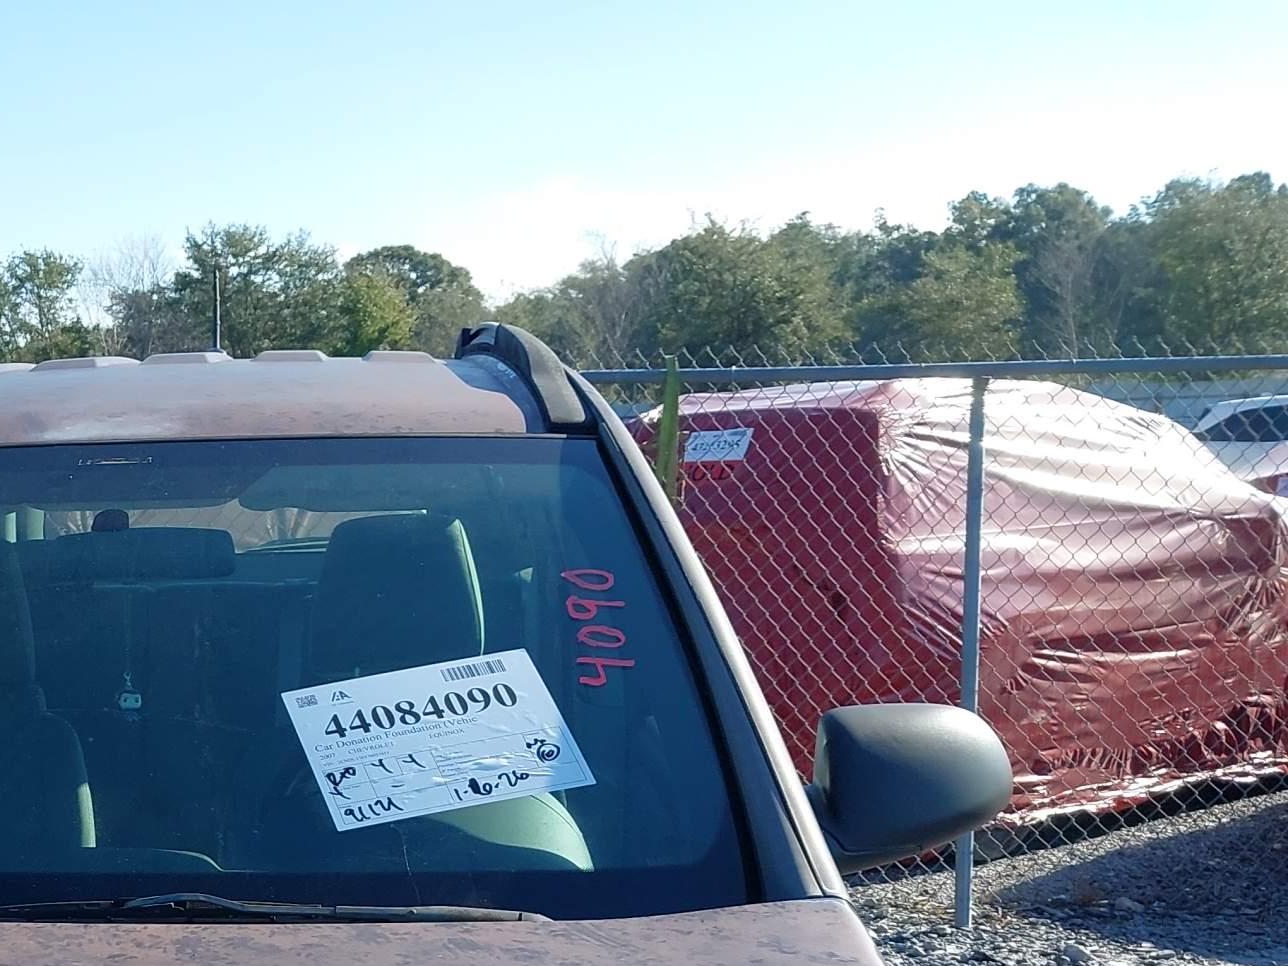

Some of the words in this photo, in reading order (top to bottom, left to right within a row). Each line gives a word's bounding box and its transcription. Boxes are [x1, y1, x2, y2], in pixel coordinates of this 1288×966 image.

[560, 569, 635, 686] 4090
[314, 744, 333, 753] Car
[336, 734, 382, 749] Donation
[384, 722, 442, 739] Foundation
[324, 683, 518, 738] 44084090
